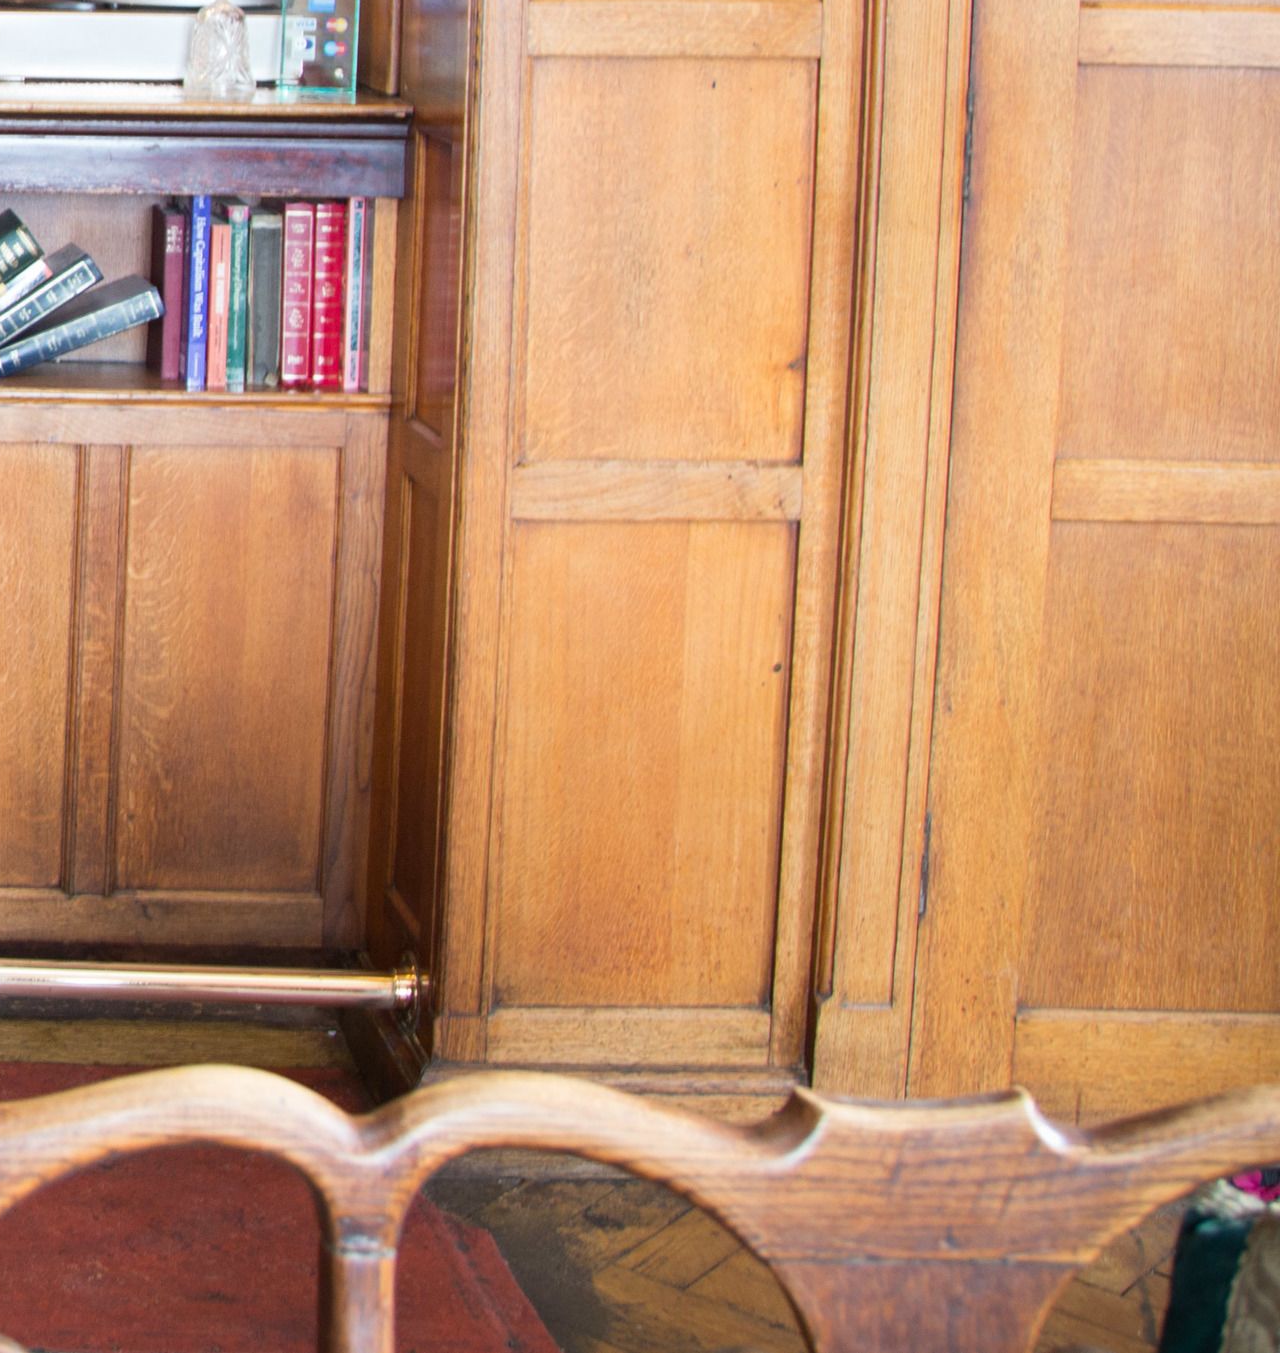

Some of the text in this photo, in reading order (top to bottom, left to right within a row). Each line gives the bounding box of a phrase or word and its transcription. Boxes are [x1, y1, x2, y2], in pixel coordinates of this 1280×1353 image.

[192, 217, 207, 338] How Capitalism Was Built
